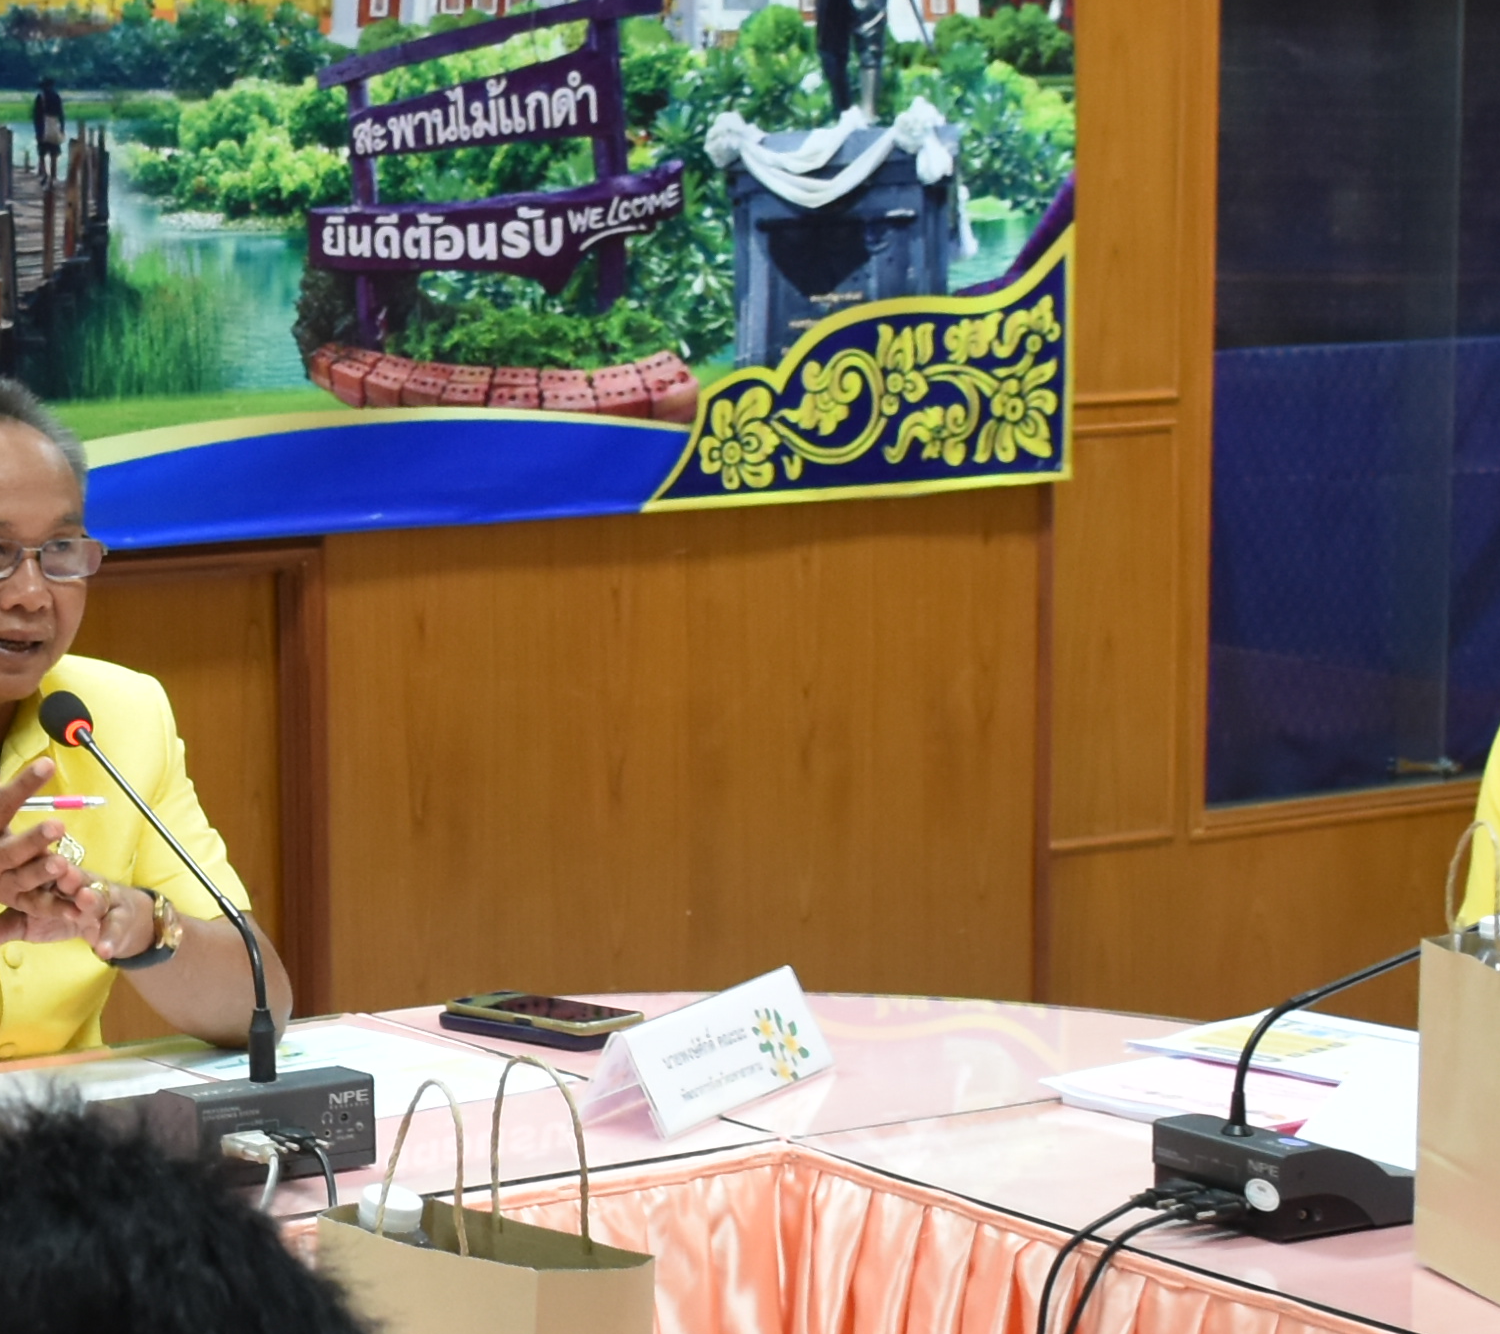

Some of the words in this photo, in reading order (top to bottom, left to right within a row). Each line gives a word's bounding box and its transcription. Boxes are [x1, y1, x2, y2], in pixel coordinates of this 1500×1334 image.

[352, 70, 599, 155] สะพานไม้แกดำ
[321, 205, 564, 261] ยินดีต้อนรับ
[567, 183, 682, 235] WELCOME
[329, 1088, 369, 1105] NPE
[1248, 1159, 1280, 1178] NPE
